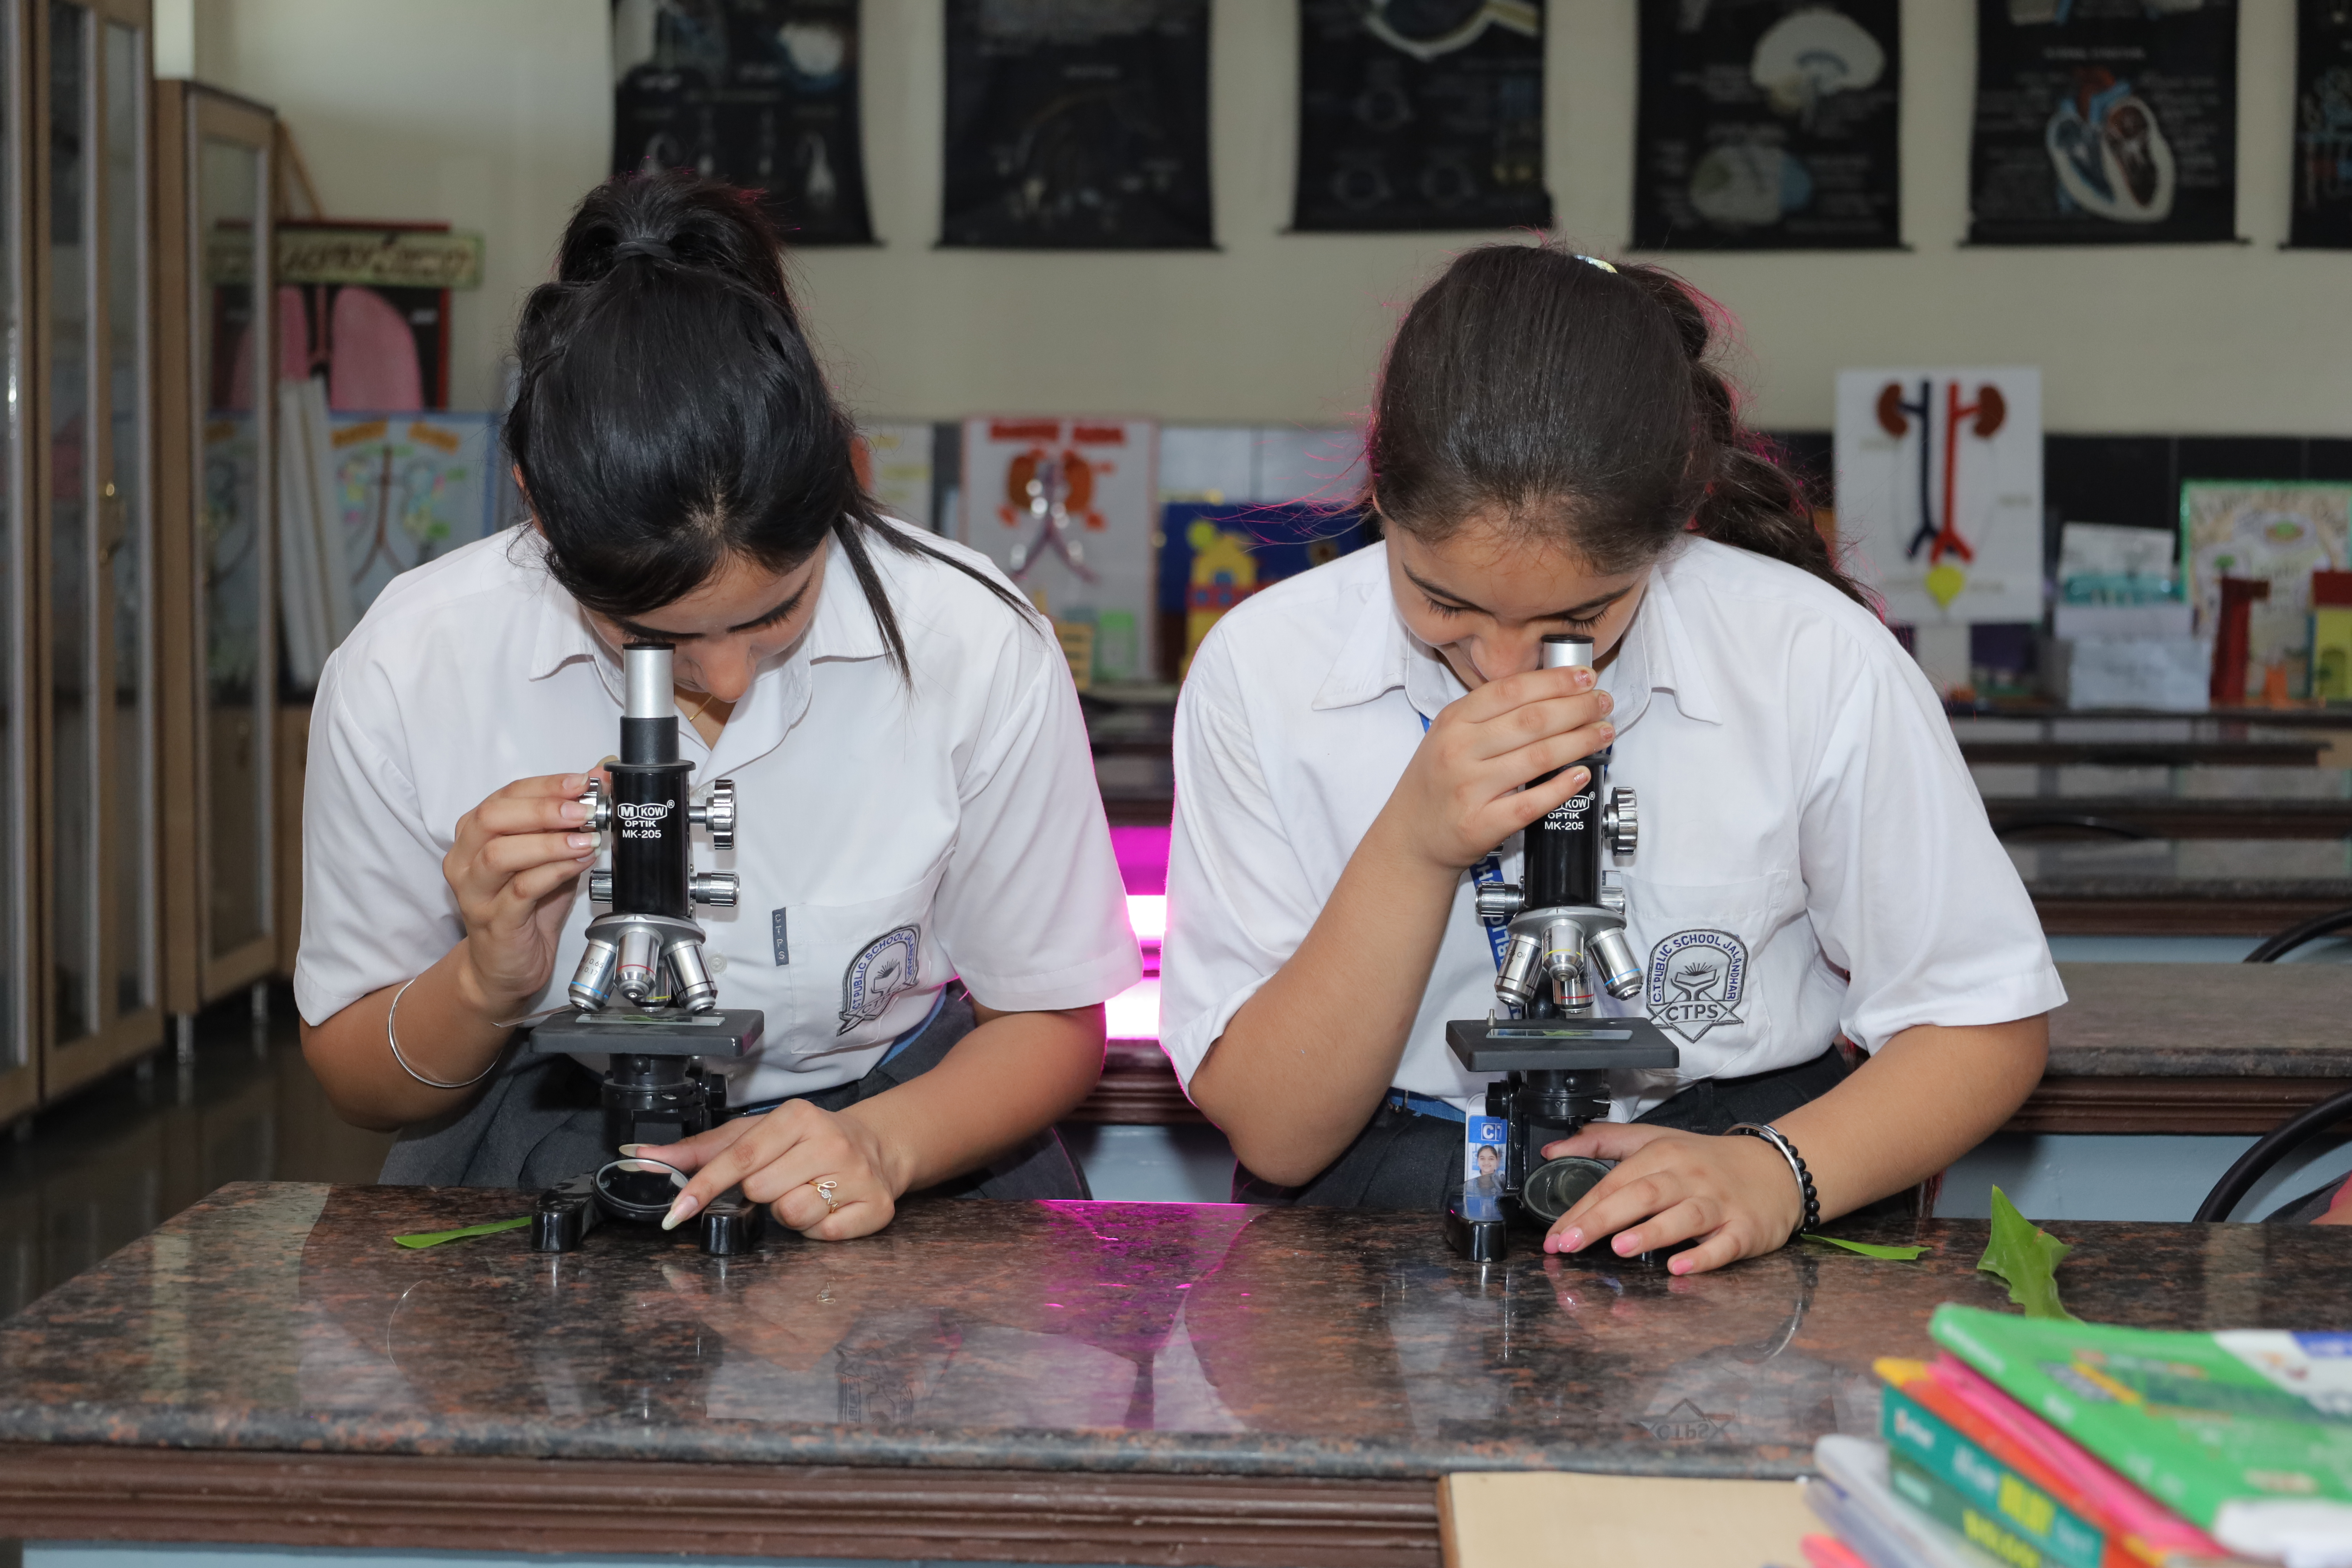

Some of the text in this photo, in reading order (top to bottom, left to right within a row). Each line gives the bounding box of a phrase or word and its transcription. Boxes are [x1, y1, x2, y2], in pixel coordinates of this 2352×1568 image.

[622, 829, 662, 838] MK-205
[1544, 821, 1584, 830] MK-205
[775, 914, 785, 959] CTPS
[853, 962, 867, 998] PUBLIC
[865, 932, 904, 960] SCHOOL
[1654, 944, 1672, 982] PUBLIC
[1673, 934, 1721, 948] SCHOOL
[1723, 942, 1742, 1000] JALANDHAR
[1665, 1004, 1718, 1021] CTPS
